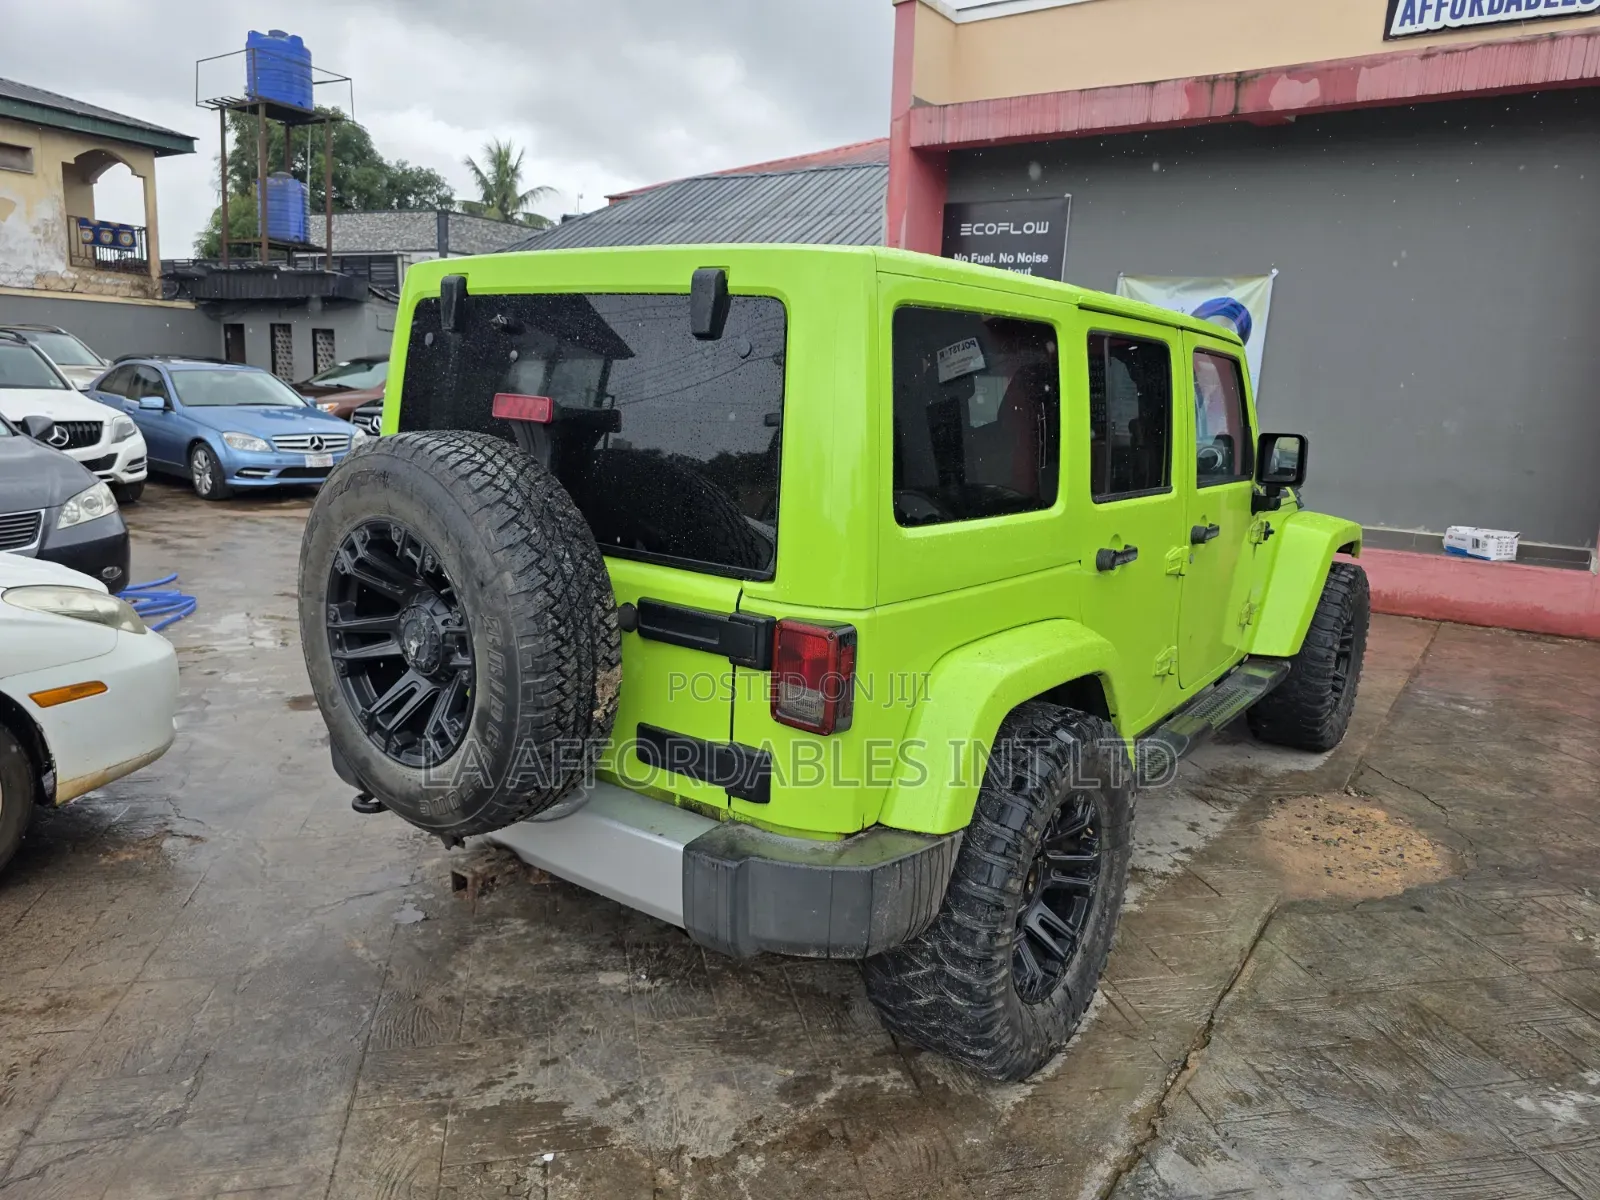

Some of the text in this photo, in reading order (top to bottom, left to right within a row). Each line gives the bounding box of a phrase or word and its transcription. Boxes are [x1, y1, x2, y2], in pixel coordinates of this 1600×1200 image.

[960, 221, 1049, 236] ECOFLOW
[953, 251, 1049, 264] No Fuel. No Noise
